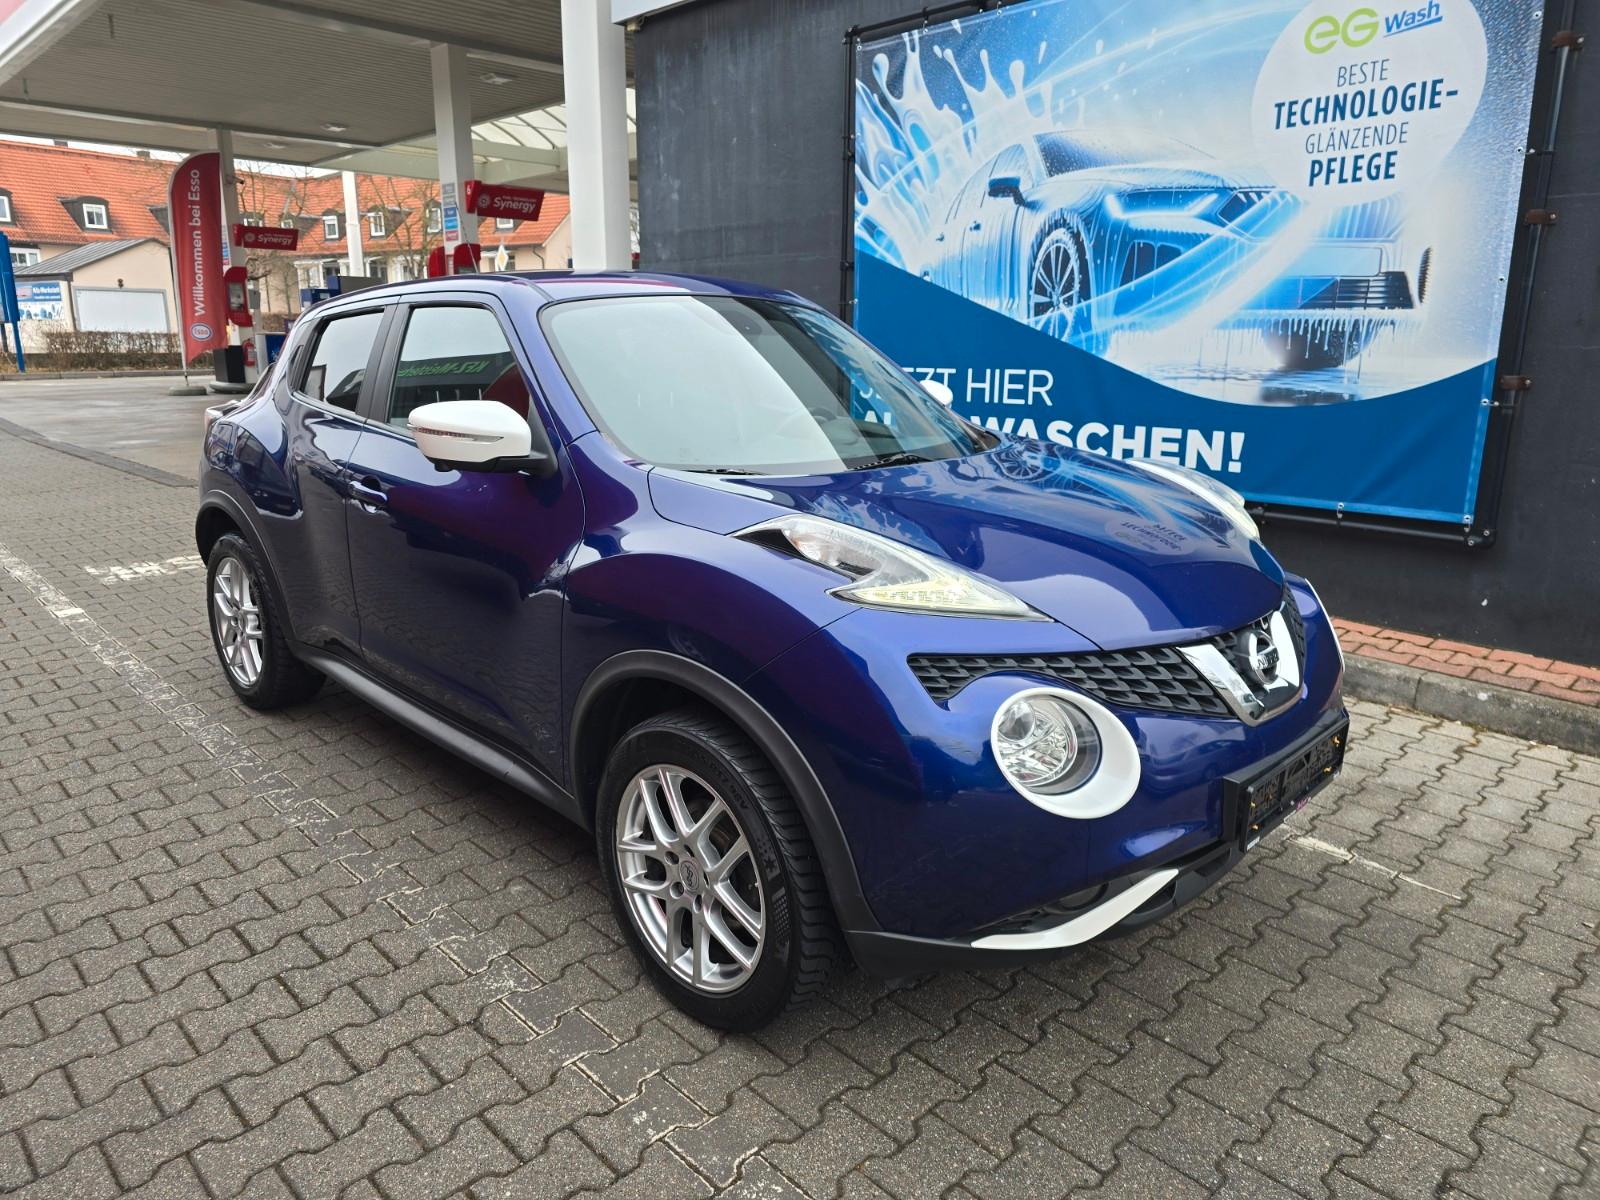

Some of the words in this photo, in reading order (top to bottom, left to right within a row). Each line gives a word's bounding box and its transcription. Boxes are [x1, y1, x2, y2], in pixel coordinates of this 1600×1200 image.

[1385, 0, 1441, 33] Wash
[1337, 58, 1390, 87] BESTE
[1274, 78, 1459, 130] TECHNOLOGIE-
[1305, 122, 1409, 154] GLÄNZENDE
[188, 169, 201, 201] Esso
[1308, 151, 1398, 187] PFLEGE
[188, 204, 202, 227] bei
[493, 196, 537, 214] Synergy
[257, 233, 294, 247] Synergy
[192, 231, 206, 316] Willkommen
[966, 367, 1053, 406] HIER
